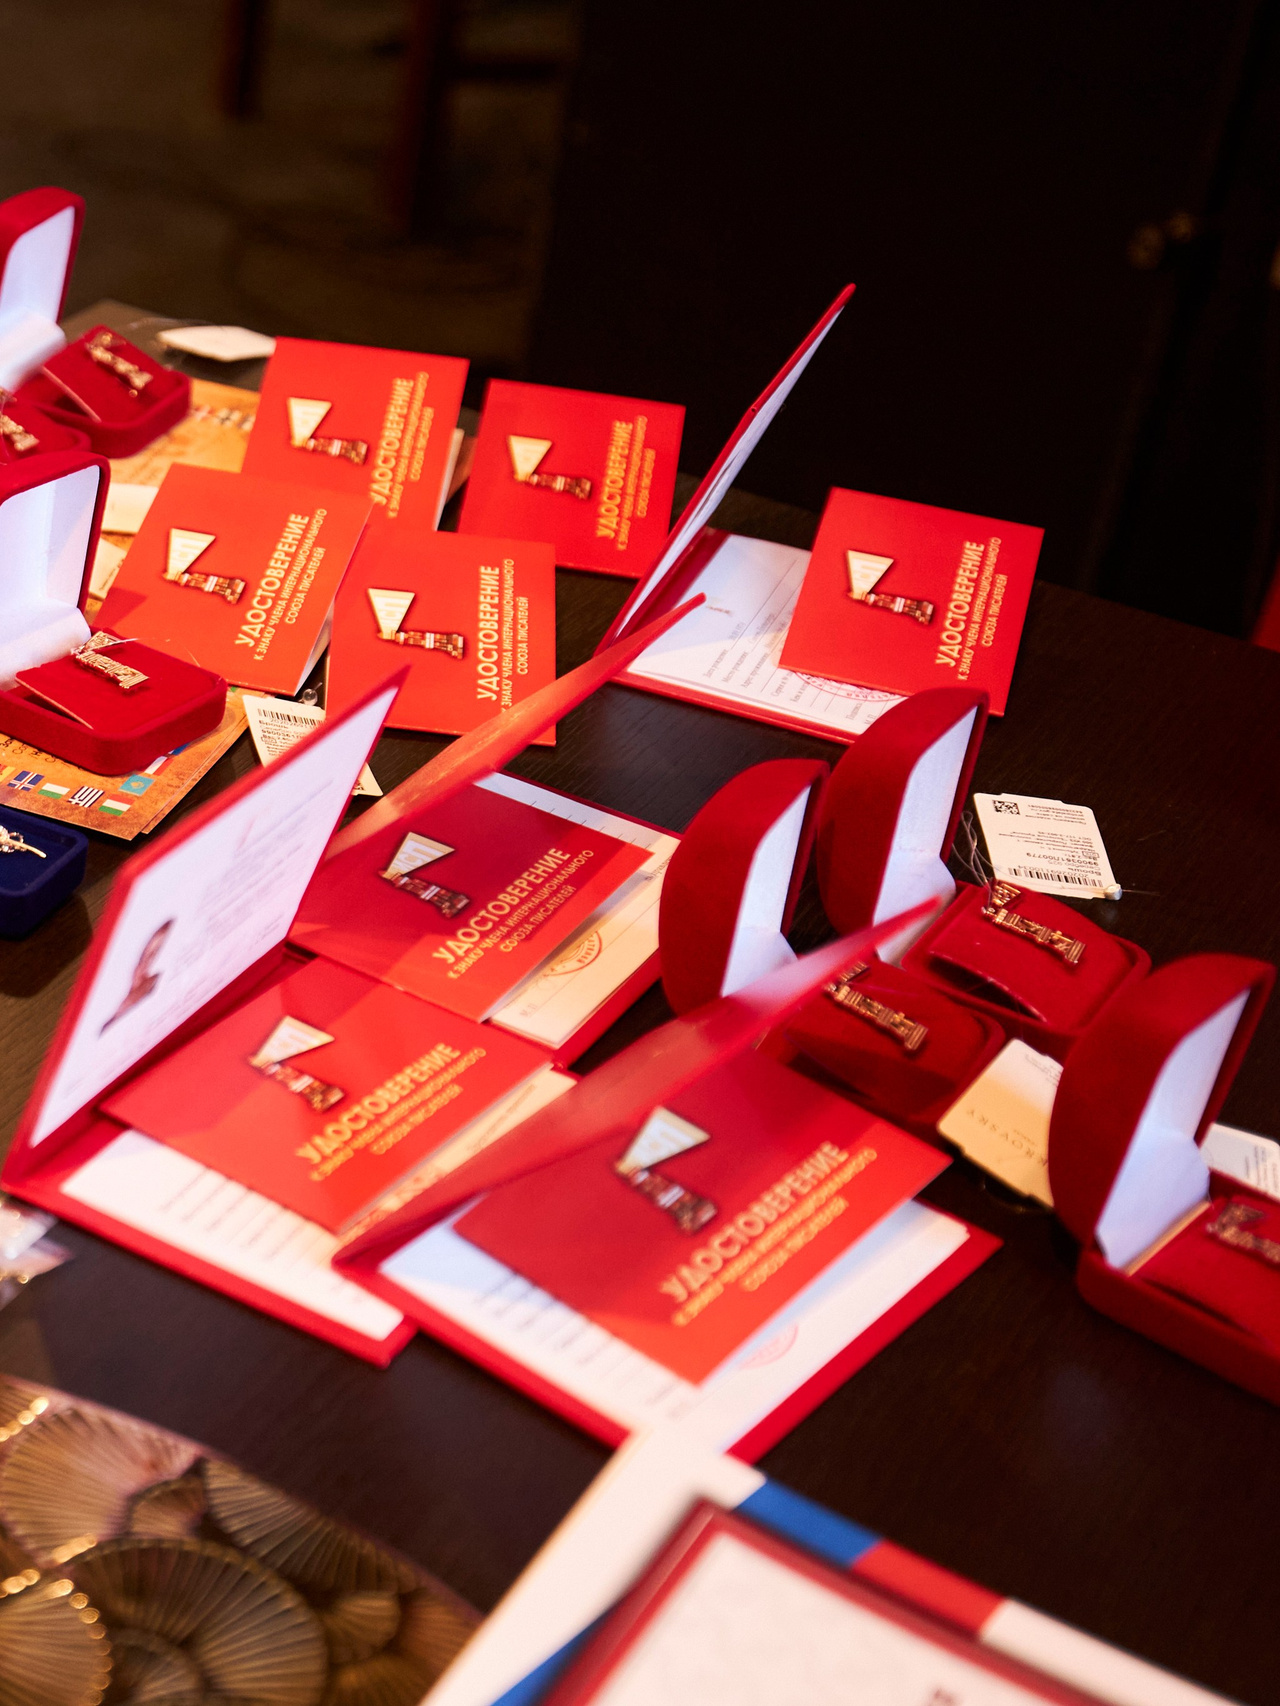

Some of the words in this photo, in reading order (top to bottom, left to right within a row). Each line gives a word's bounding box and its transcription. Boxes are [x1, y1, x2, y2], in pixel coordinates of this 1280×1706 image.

[370, 378, 413, 506] УДОСТОВЕРЕНИЕ
[596, 420, 633, 539] УДОСТОВЕРЕНИЕ
[235, 513, 309, 647] УДОСТОВЕРЕНИЕ
[256, 627, 275, 654] ЗНАКУ
[269, 600, 287, 626] ЧЛЕНА
[281, 509, 327, 599] ИНТЕРНАЦИОНАЛЬНОГО
[285, 592, 306, 624] СОЮЗА
[300, 546, 326, 590] ПИСАТЕЛЕЙ
[503, 559, 514, 650] ИНТЕРНАЦИОНАЛЬНОГО
[516, 596, 528, 641] ПИСАТЕЛЕЙ
[935, 541, 985, 667] УДОСТОВЕРЕНИЕ
[973, 537, 1001, 620] ИНТЕРНАЦИОНАЛЬНОГО
[982, 617, 997, 647] СОЮЗА
[990, 574, 1008, 616] ПИСАТЕЛЕЙ
[477, 565, 499, 701] УДОСТОВЕРЕНИЕ
[503, 651, 512, 678] ЧЛЕНА
[517, 643, 528, 675] СОЮЗА
[960, 647, 974, 674] ЗНАКУ
[968, 620, 980, 646] ЧЛЕНА
[501, 679, 512, 706] ЗНАКУ
[432, 848, 571, 964] УДОСТОВЕРЕНИЕ
[454, 948, 484, 974] ЗНАКУ
[480, 925, 510, 950] ЧЛЕНА
[507, 850, 594, 927] ИНТЕРНАЦИОНАЛЬНОГО
[500, 924, 535, 952] СОЮЗА
[530, 884, 577, 925] ПИСАТЕЛЕЙ
[295, 1042, 461, 1164] УДОСТОВЕРЕНИЕ
[966, 1108, 1048, 1167] KROVSKY
[659, 1140, 849, 1302] УДОСТОВЕРЕНИЕ
